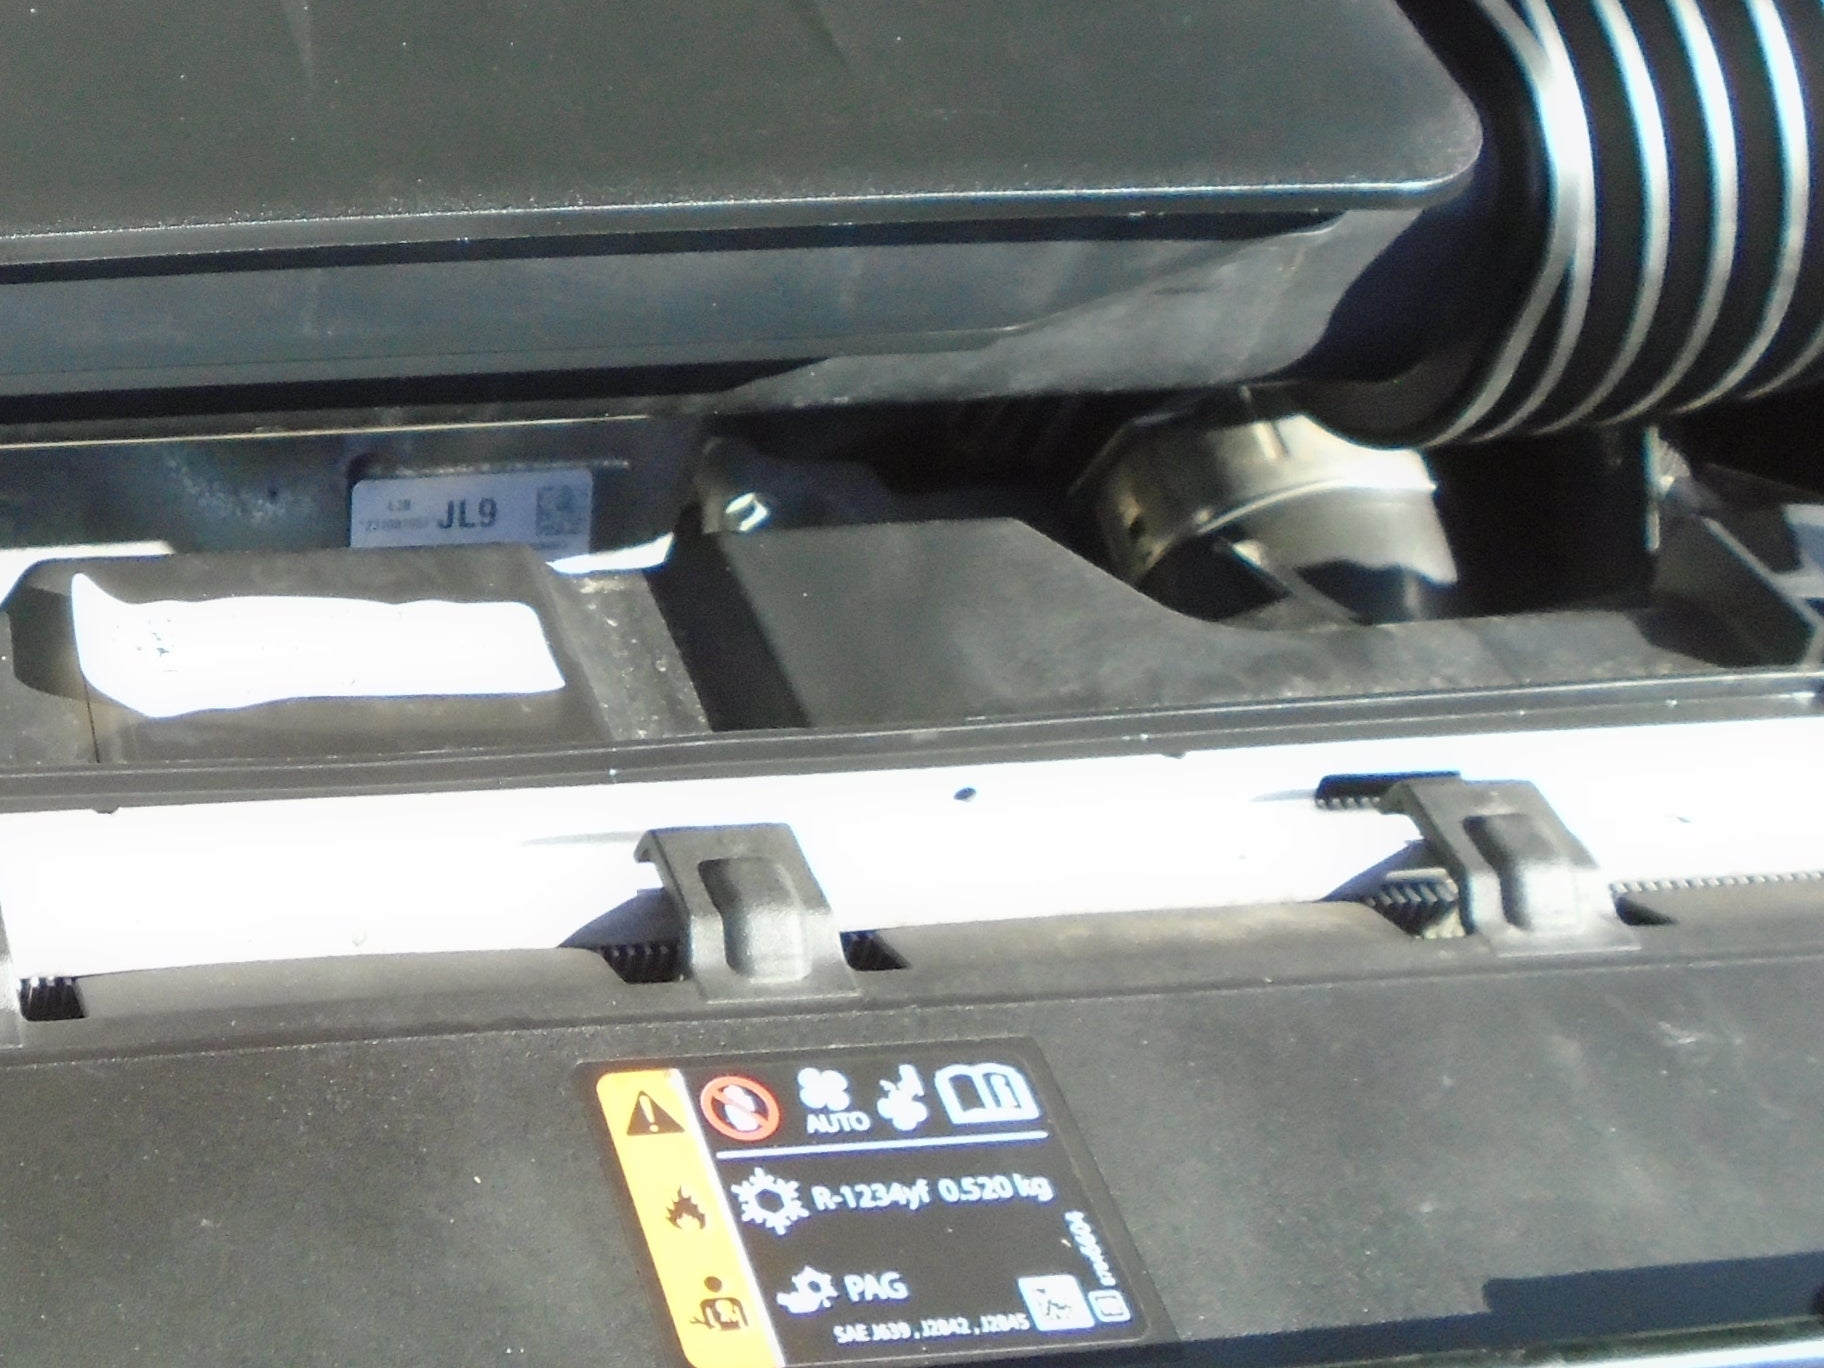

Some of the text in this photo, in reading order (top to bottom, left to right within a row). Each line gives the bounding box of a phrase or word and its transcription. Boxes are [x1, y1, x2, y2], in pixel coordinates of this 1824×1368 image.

[436, 497, 498, 530] JL9
[806, 1111, 871, 1134] AUTO
[812, 1173, 1054, 1210] R-1234yf 0.520 kg
[843, 1271, 909, 1303] PAG
[833, 1324, 871, 1344] SAE
